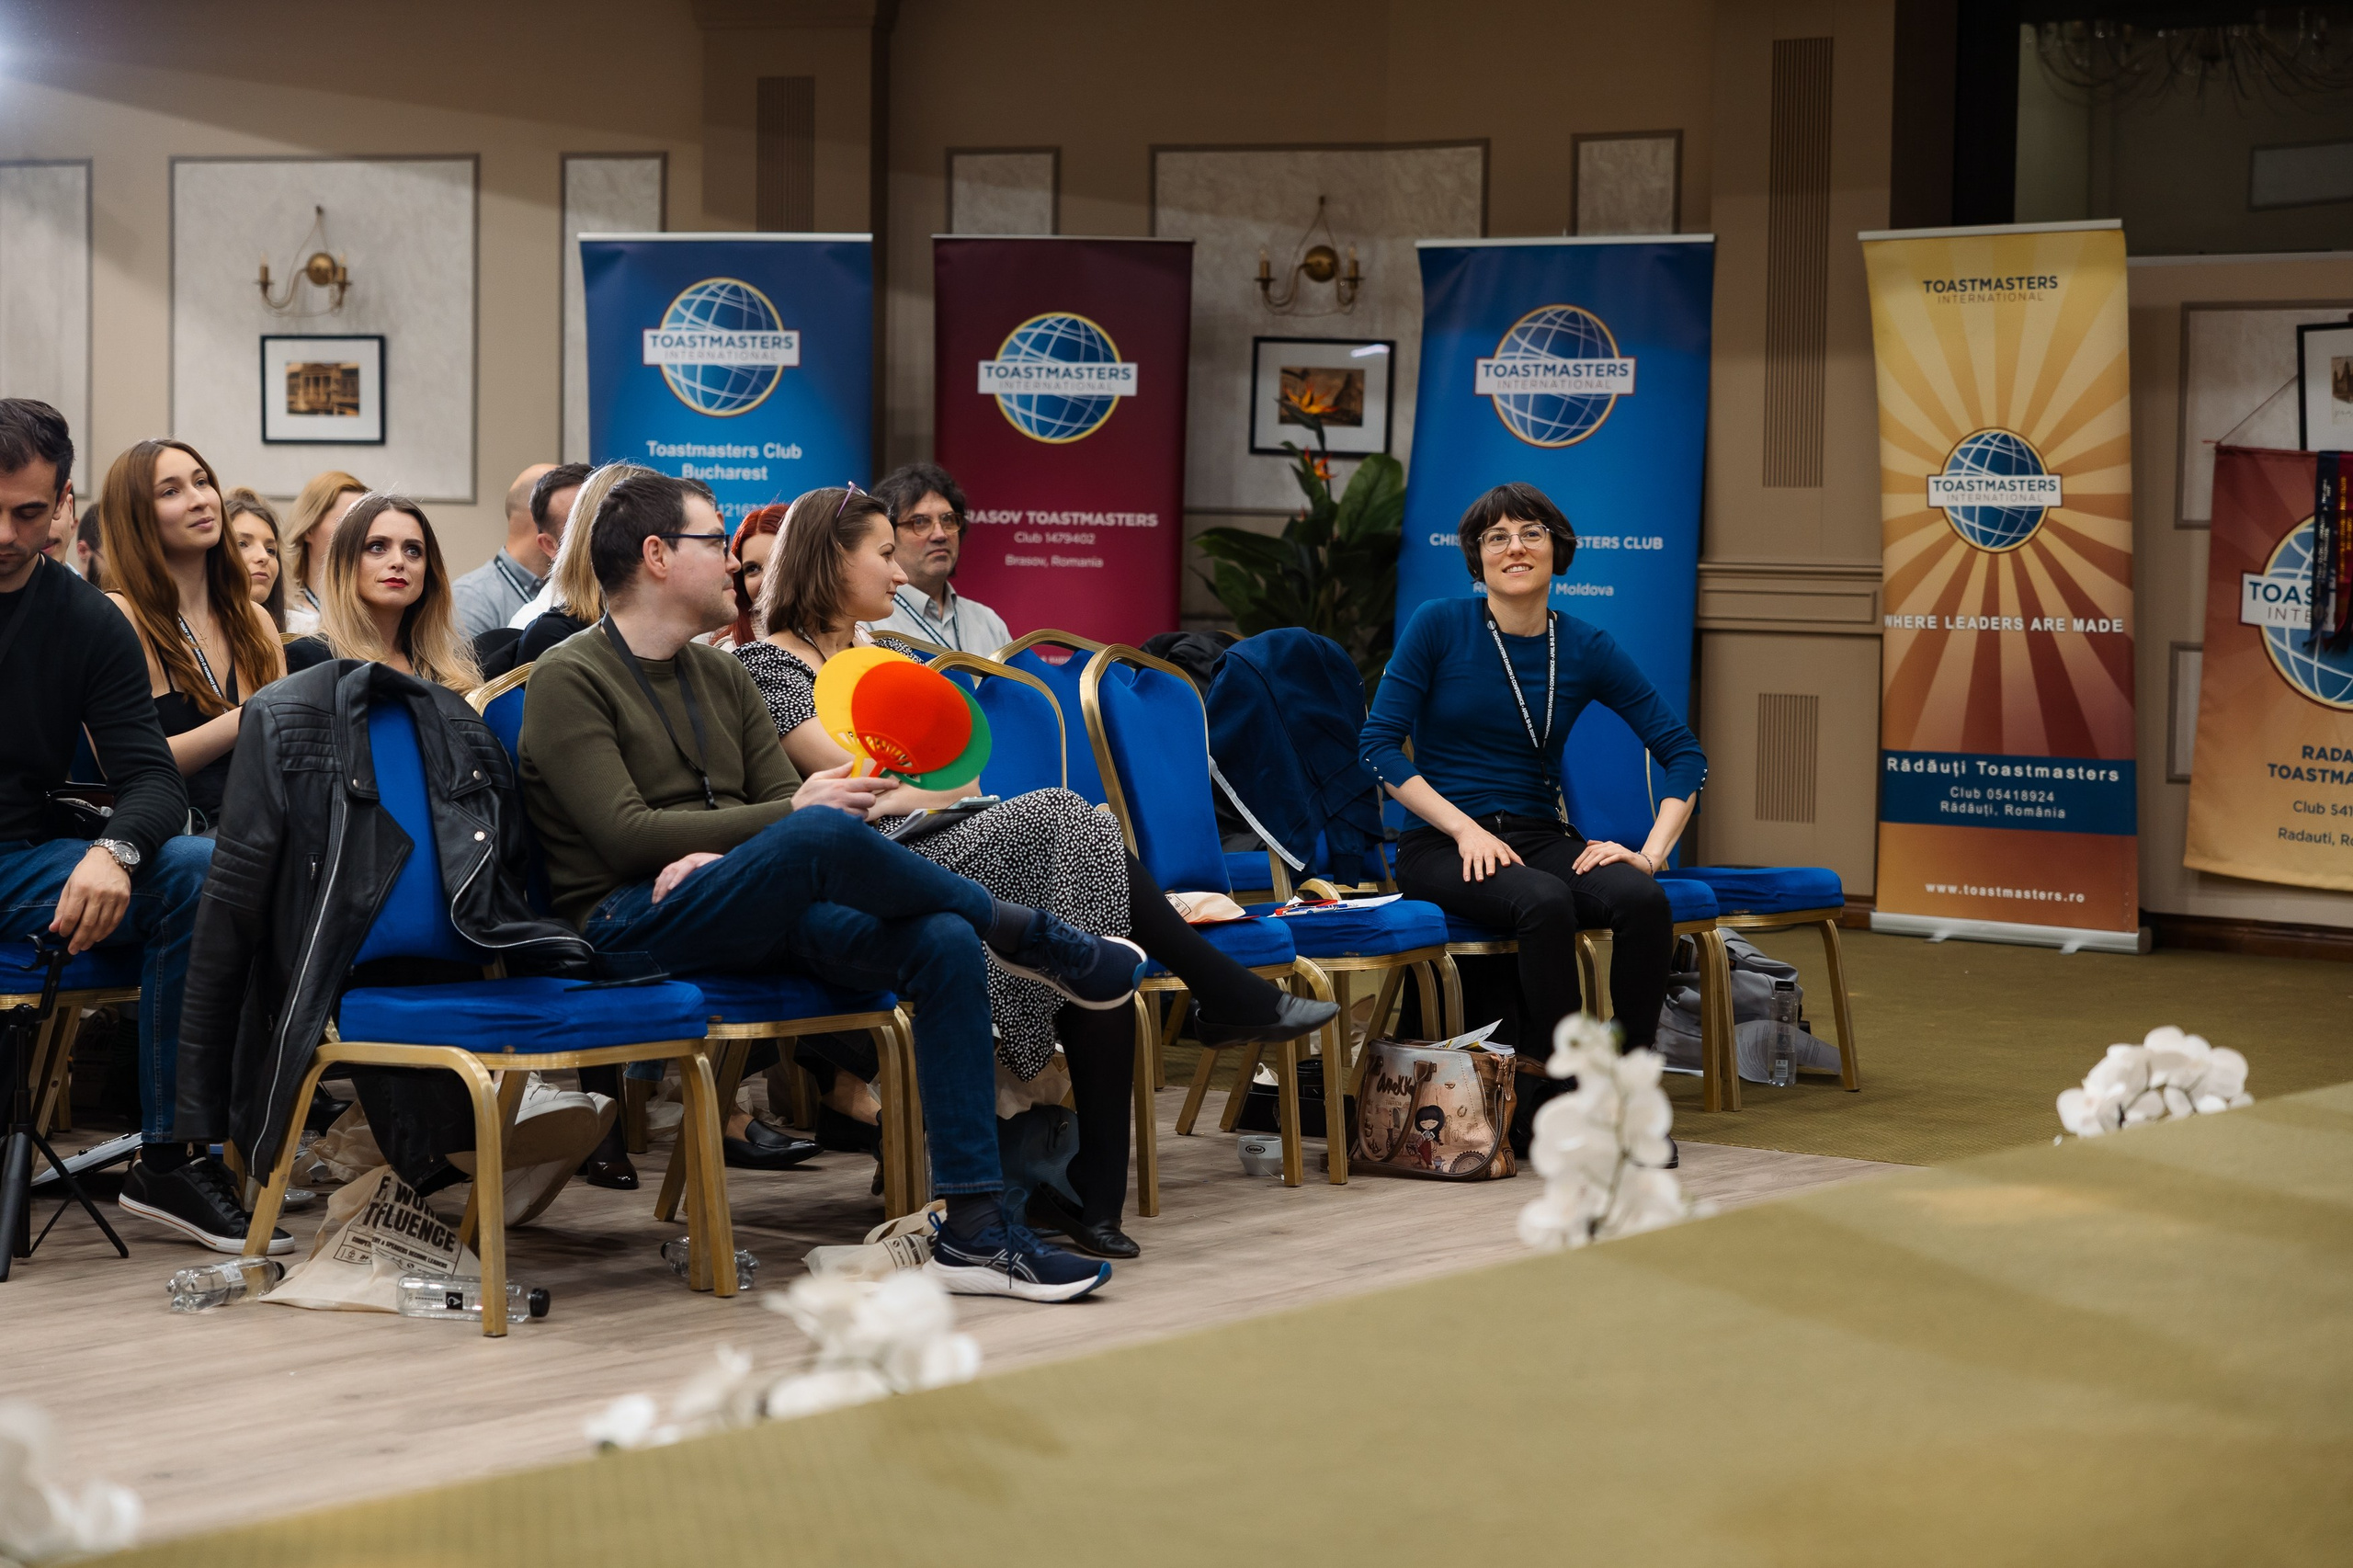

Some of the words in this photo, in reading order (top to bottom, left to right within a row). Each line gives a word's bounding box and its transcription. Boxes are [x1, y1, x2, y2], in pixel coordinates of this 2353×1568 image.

[1923, 276, 2058, 294] TOASTMASTERS
[1938, 291, 2044, 305] INTERNATIONAL
[650, 335, 793, 349] TOASTMASTERS
[665, 349, 777, 362] INTERNATIONAL
[984, 366, 1131, 381] TOASTMASTERS
[1483, 363, 1629, 378] TOASTMASTERS
[999, 380, 1114, 392] INTERNATIONAL
[1496, 379, 1612, 391] INTERNATIONAL
[645, 440, 759, 459] Toastmasters
[763, 442, 802, 460] Club
[681, 462, 768, 481] Bucharest
[1933, 479, 2057, 493] TOASTMASTERS
[1947, 494, 2044, 504] INTERNATIONAL
[965, 509, 1022, 525] RASOV
[1026, 510, 1159, 528] TOASTMASTERS
[1014, 531, 1042, 543] Club
[1623, 536, 1664, 551] CLUB
[1005, 553, 1049, 568] Brasov,
[1051, 555, 1104, 568] Romania
[1555, 582, 1615, 597] Moldova
[1884, 614, 1938, 630] WHERE
[1945, 615, 2024, 631] LEADERS
[2030, 617, 2066, 632] ARE
[2073, 618, 2124, 633] MADE
[1976, 760, 2120, 782] Toastmasters
[1949, 786, 1982, 800] Club
[2292, 800, 2326, 815] Club
[2278, 827, 2336, 846] Radauti,
[1926, 882, 2086, 903] www.toastmasters.ro
